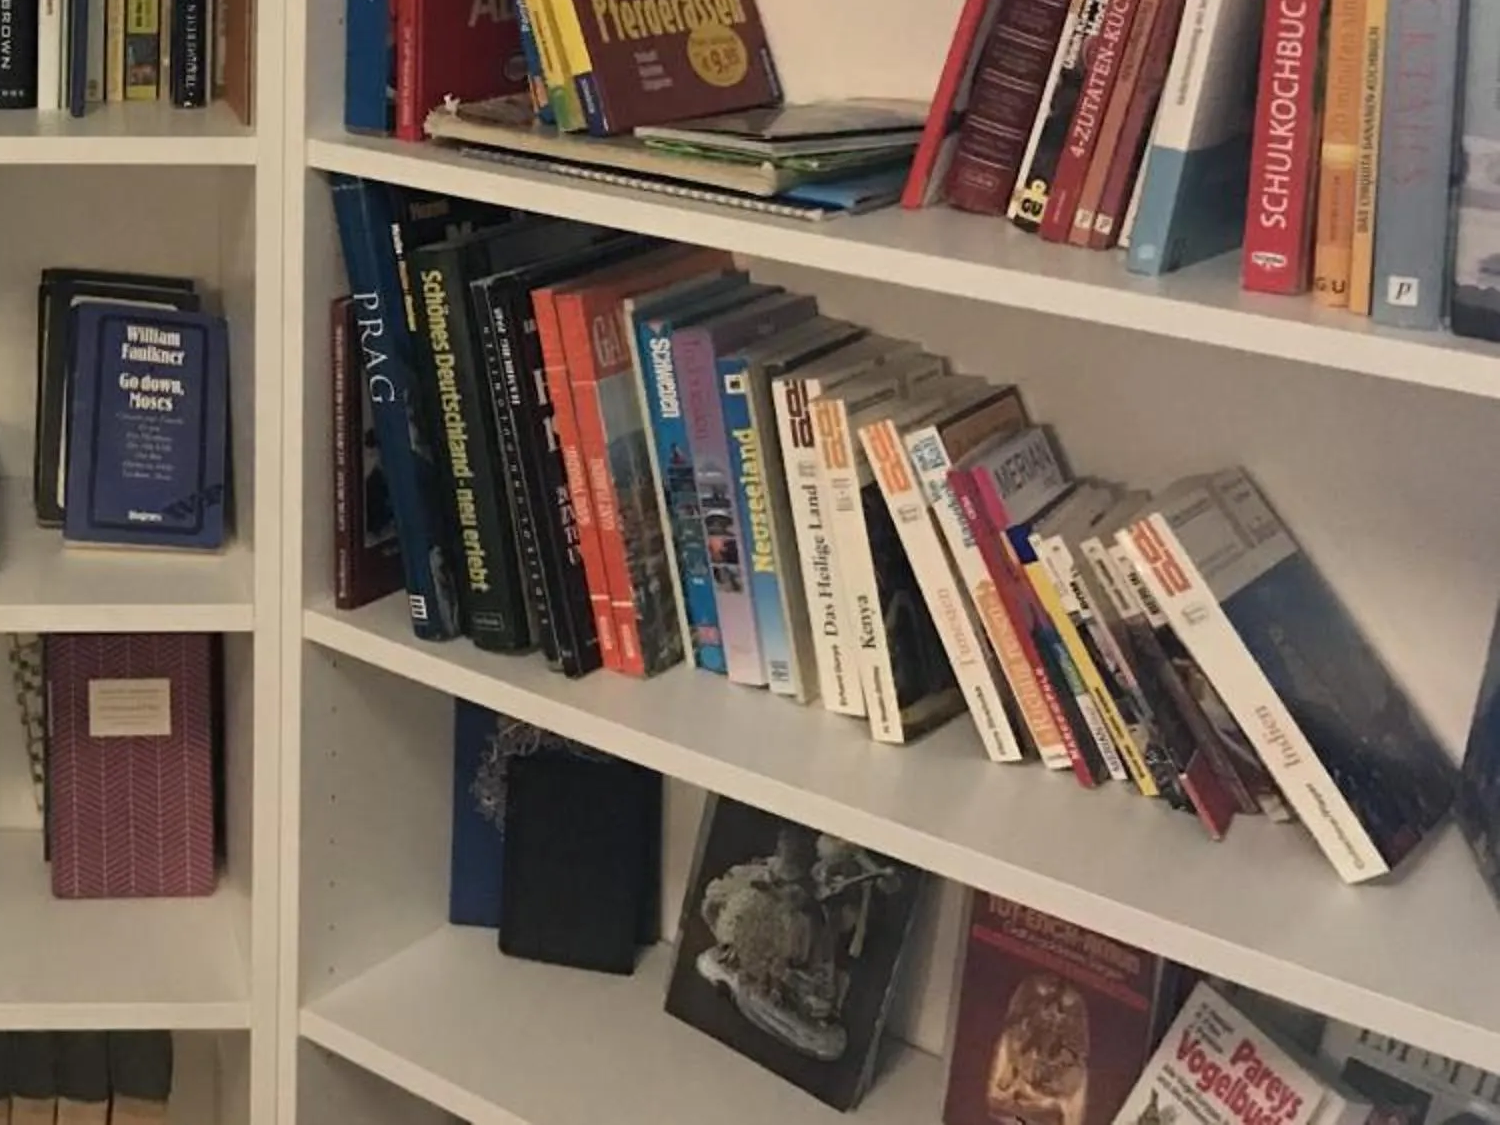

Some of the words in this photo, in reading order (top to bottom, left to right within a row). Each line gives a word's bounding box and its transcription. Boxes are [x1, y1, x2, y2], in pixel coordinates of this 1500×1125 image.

[126, 325, 182, 347] William
[419, 269, 450, 355] Schönes
[120, 342, 186, 366] Faulkner
[352, 289, 396, 405] PRAG
[119, 372, 139, 390] Go
[139, 374, 185, 396] down,
[128, 391, 174, 413] Moses
[435, 353, 474, 479] Deutschland
[454, 486, 477, 520] neu
[732, 425, 774, 573] Neuseeland
[804, 483, 822, 528] Land
[460, 522, 490, 594] erlebt
[812, 531, 837, 601] Heilige
[823, 603, 841, 638] Das
[859, 595, 878, 650] Kenya
[1251, 702, 1302, 770] Indien
[1229, 1037, 1305, 1116] Pareys
